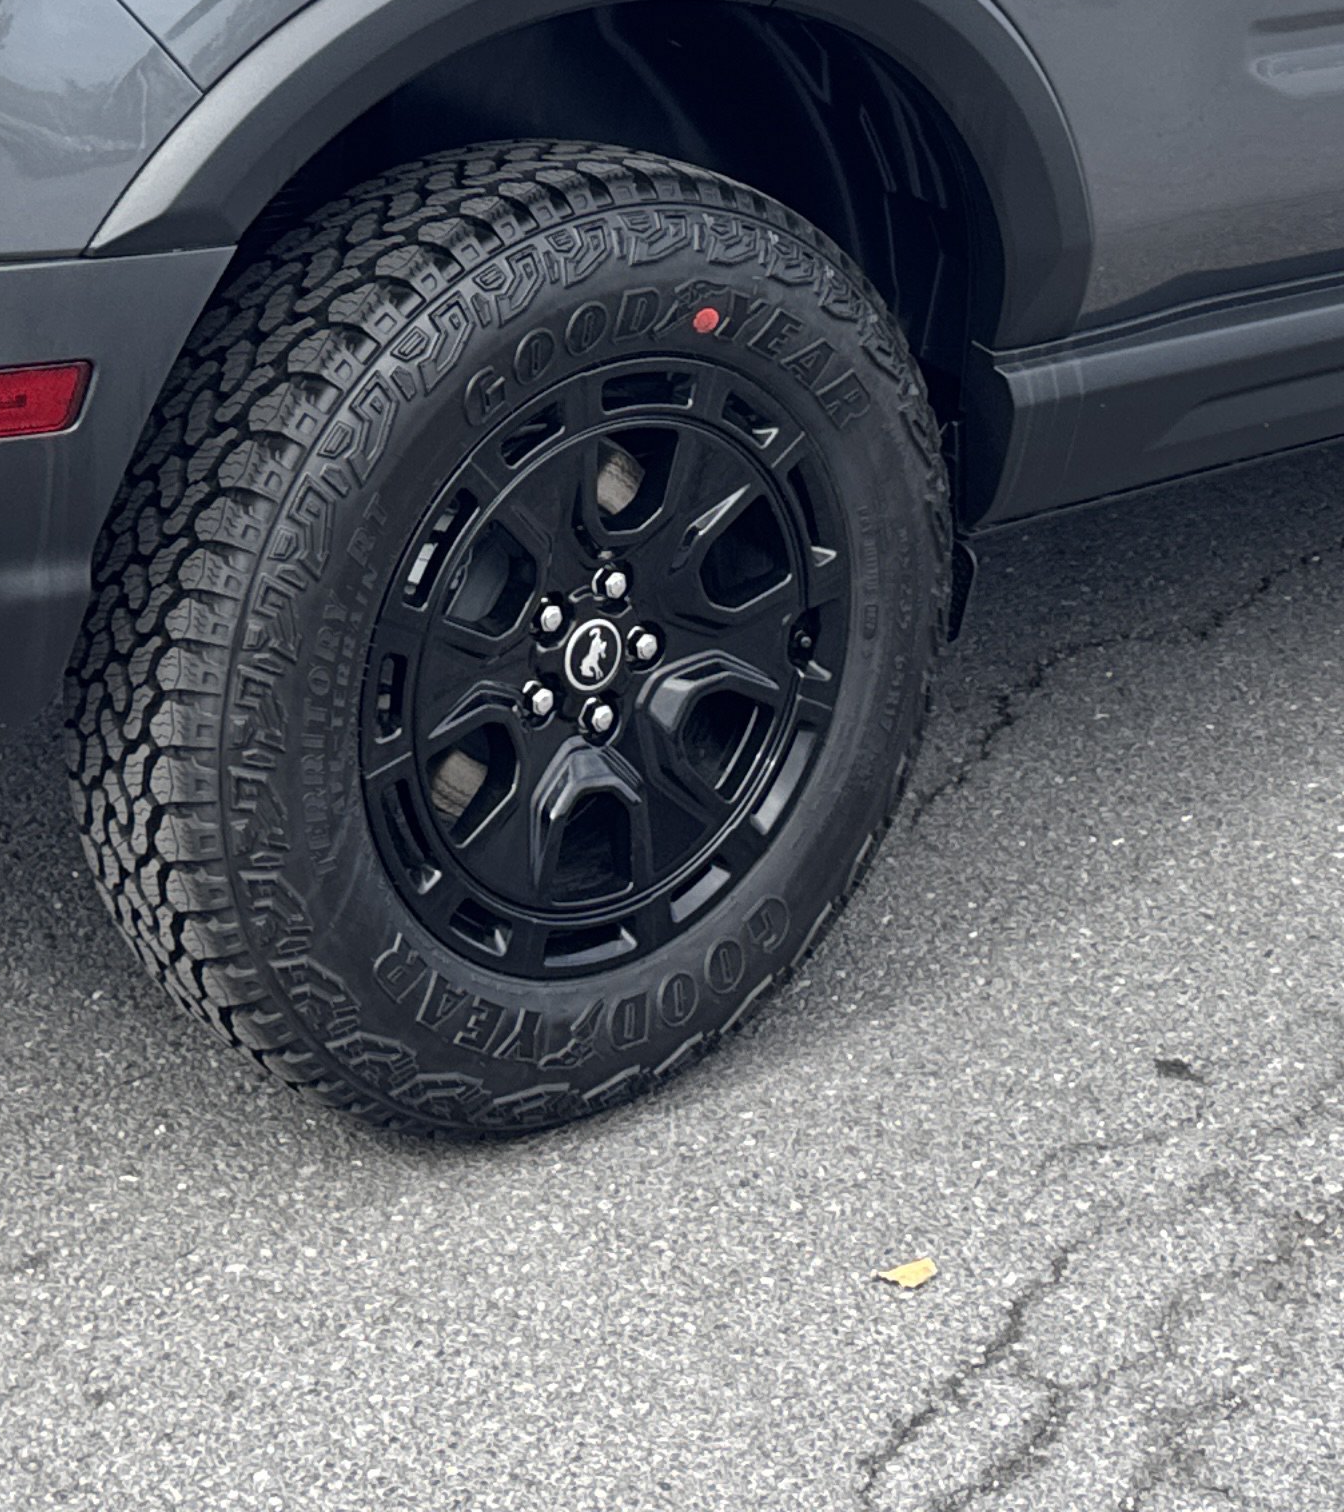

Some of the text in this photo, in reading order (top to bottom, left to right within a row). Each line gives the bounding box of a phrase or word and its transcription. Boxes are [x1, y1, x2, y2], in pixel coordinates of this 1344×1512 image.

[464, 280, 872, 429] GOODYEAR
[299, 491, 389, 876] TERRITORY RT
[372, 894, 791, 1070] GOODYEAR
